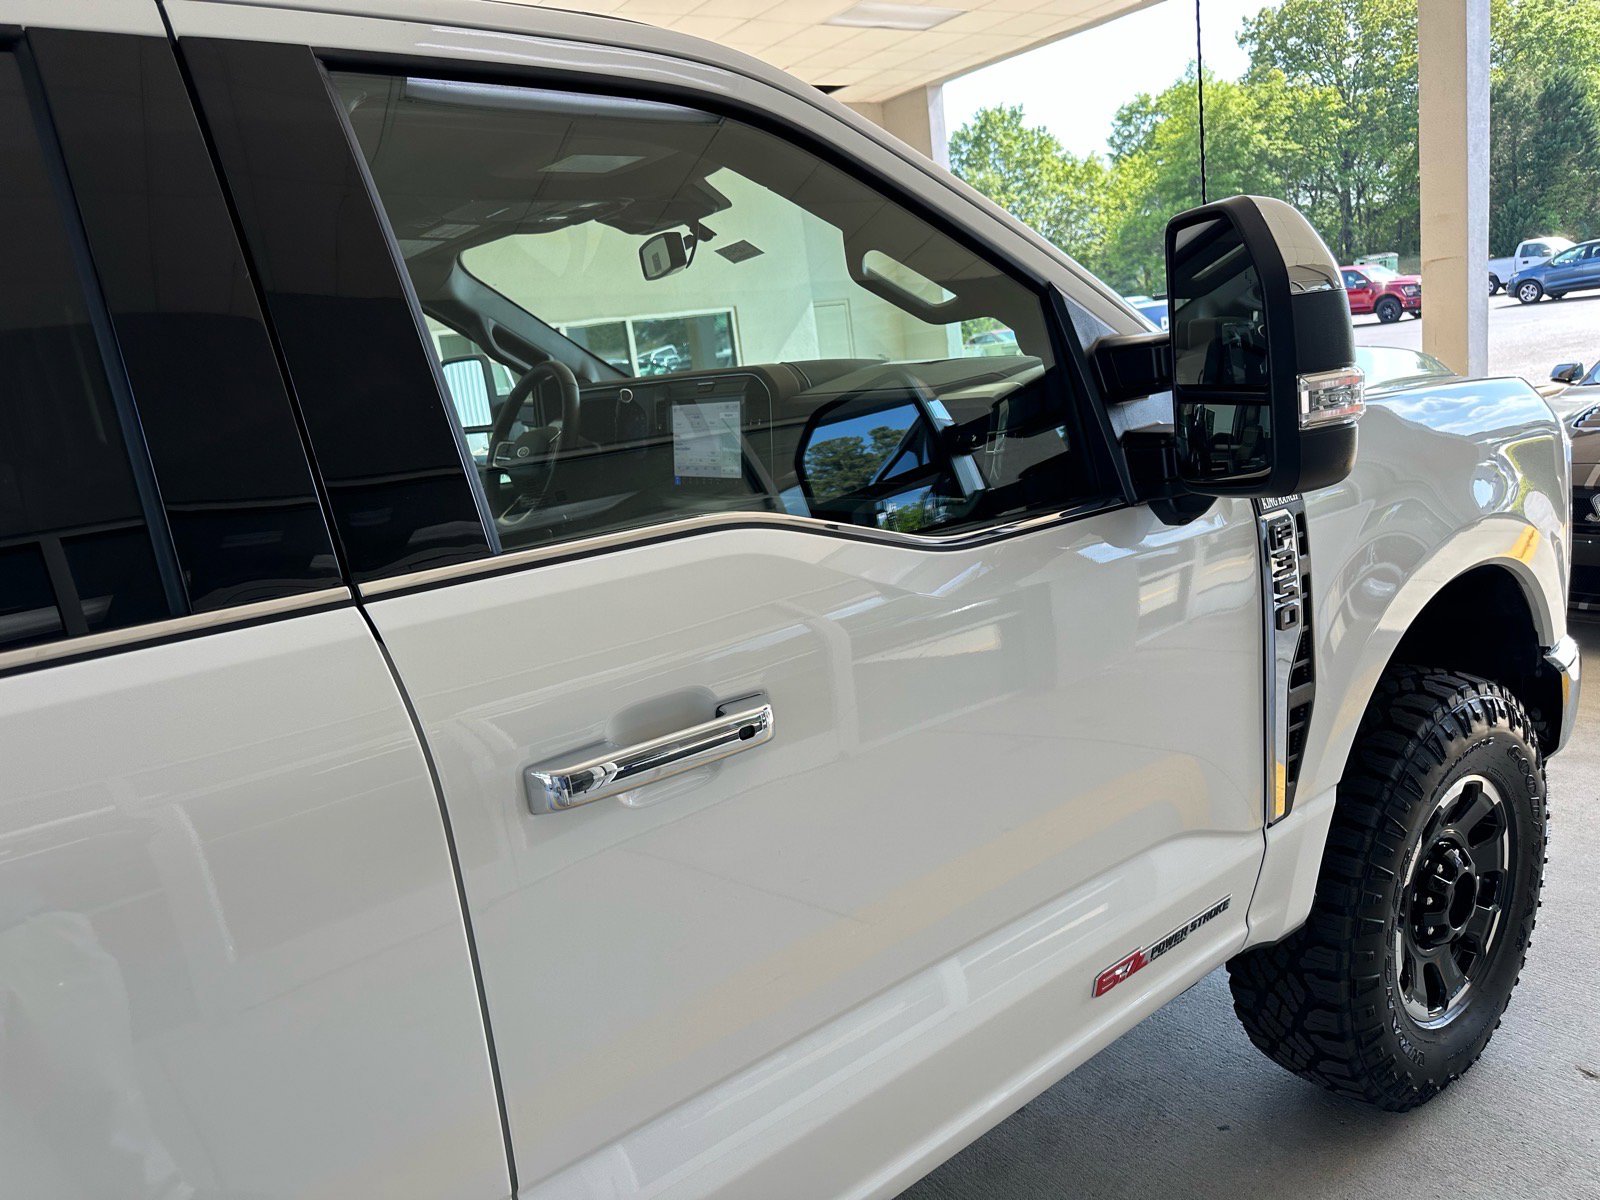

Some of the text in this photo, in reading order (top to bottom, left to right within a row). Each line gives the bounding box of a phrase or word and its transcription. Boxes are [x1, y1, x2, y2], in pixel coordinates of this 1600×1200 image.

[1261, 496, 1279, 510] KING
[1095, 950, 1149, 998] 6.7L
[1150, 925, 1189, 959] POWER
[1189, 897, 1232, 932] STROKE
